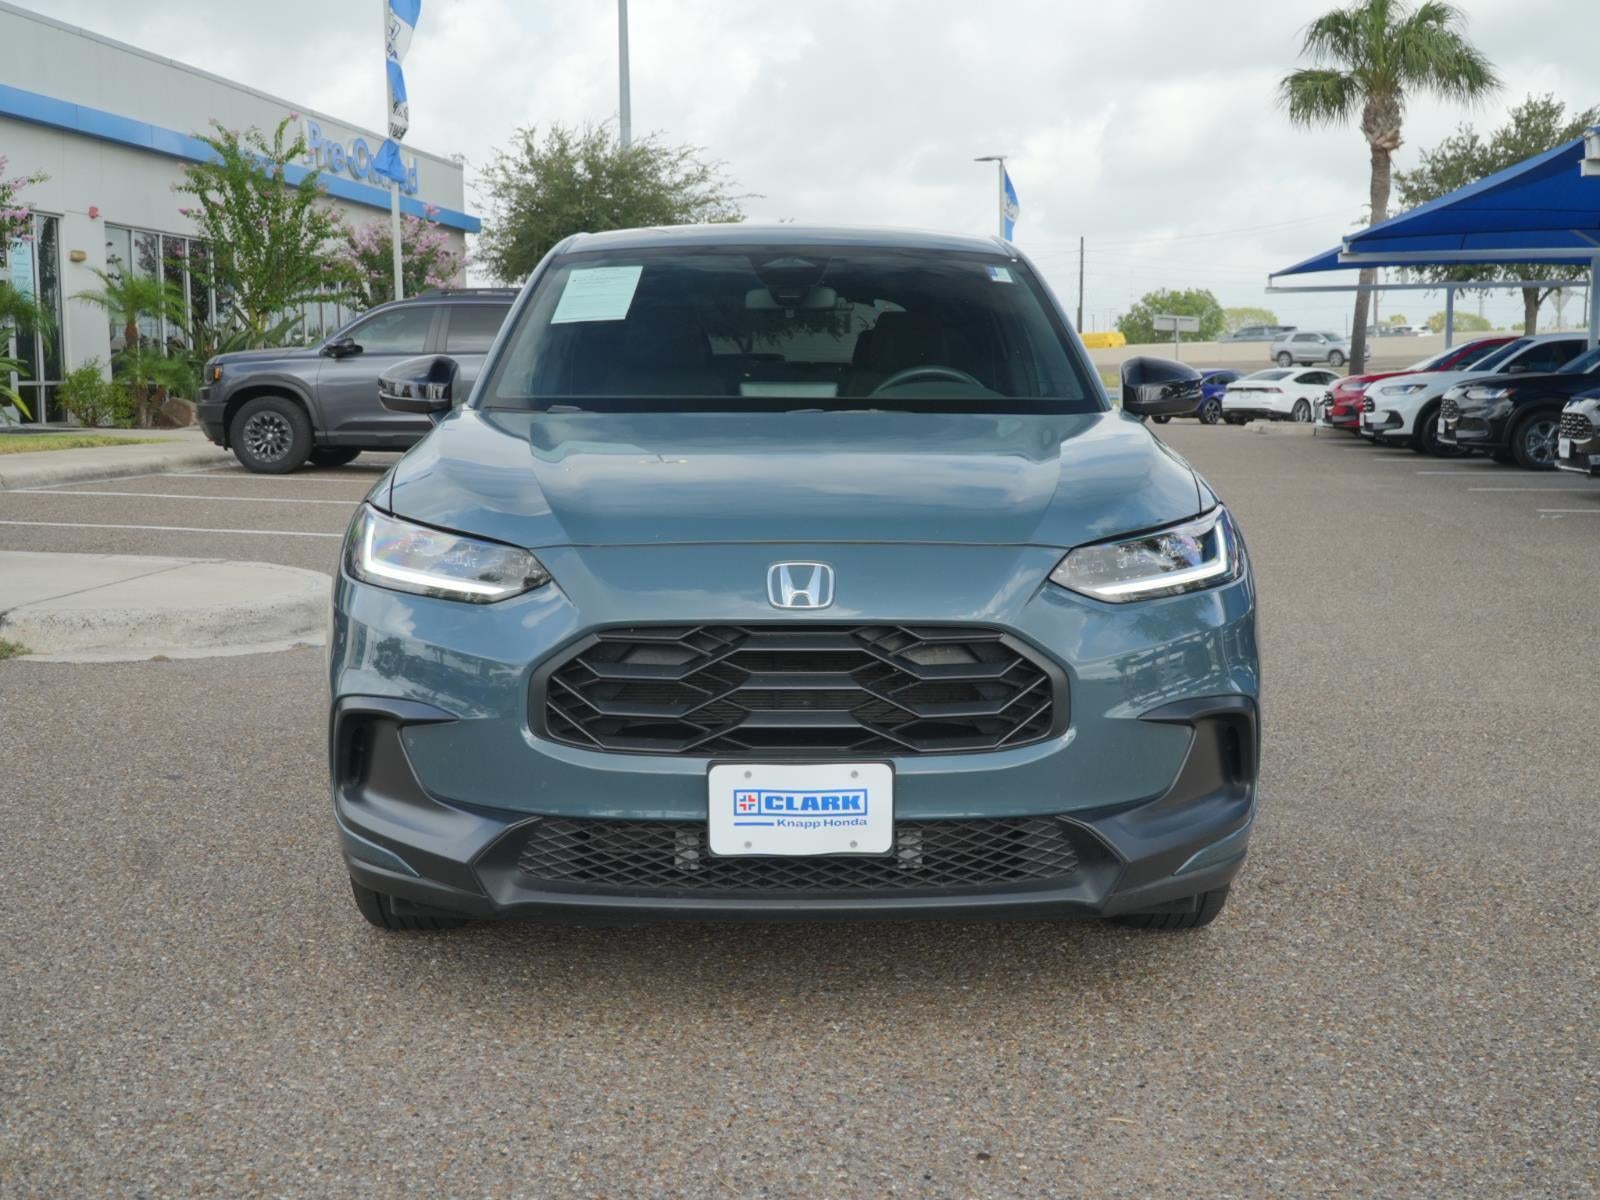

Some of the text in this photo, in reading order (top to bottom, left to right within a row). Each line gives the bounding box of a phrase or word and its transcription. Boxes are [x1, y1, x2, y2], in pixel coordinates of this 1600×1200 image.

[305, 119, 419, 195] Pre-Od
[764, 795, 862, 811] CLARK
[776, 818, 868, 829] Knapp Honda
